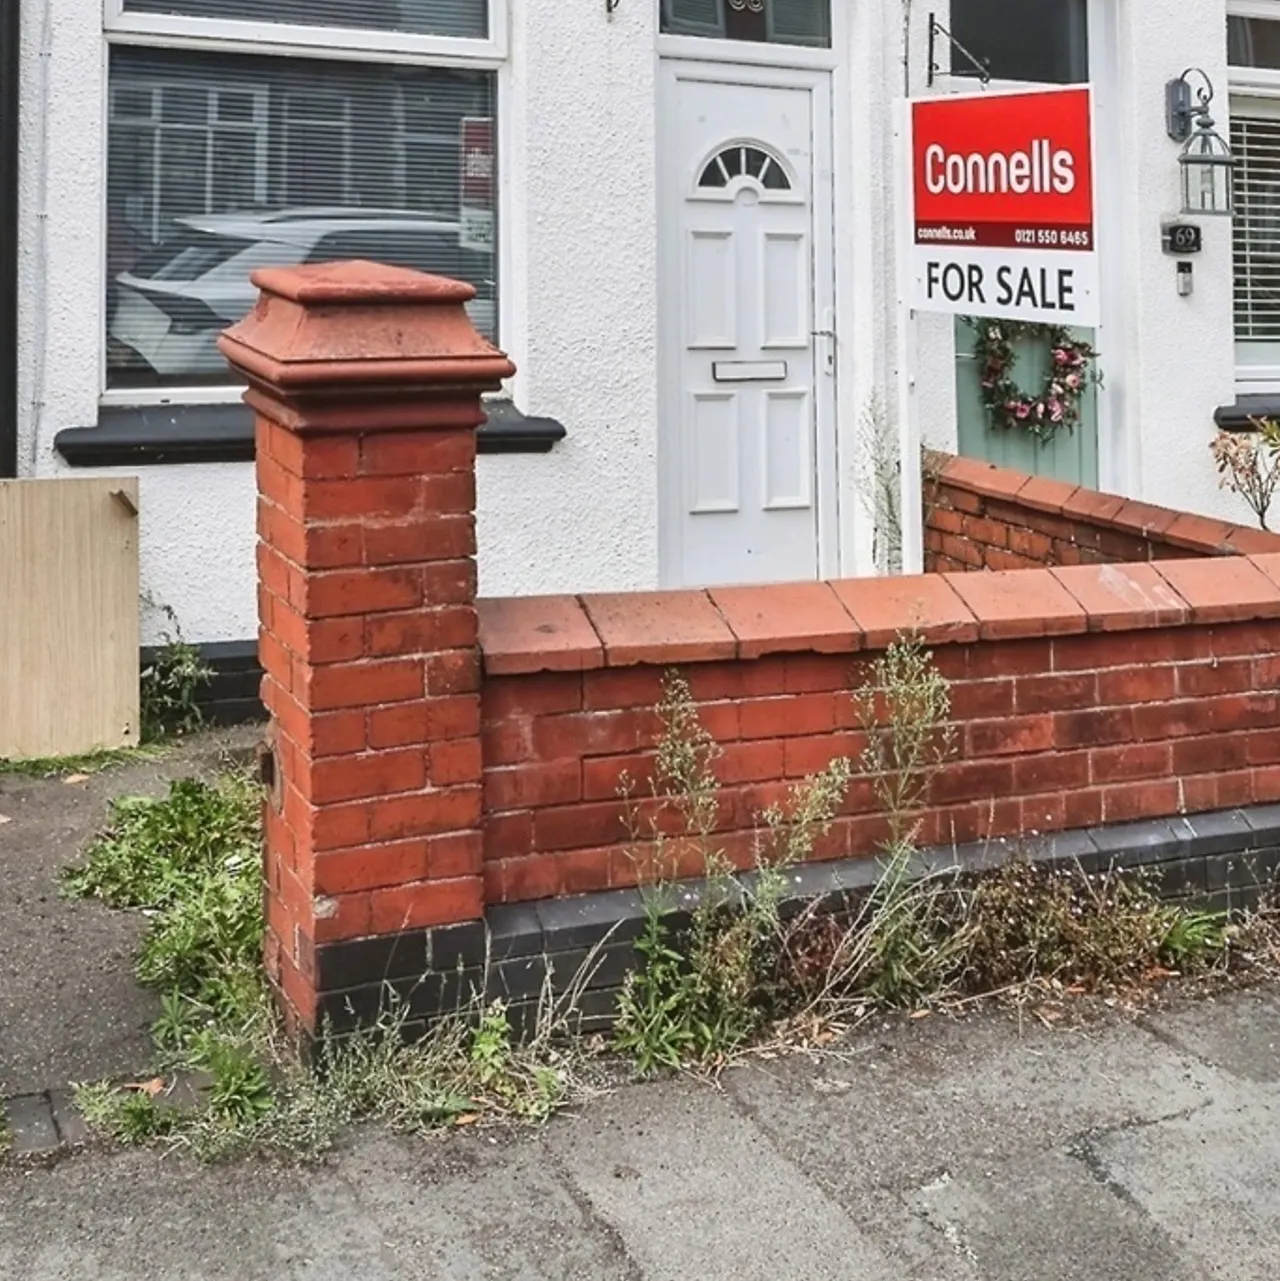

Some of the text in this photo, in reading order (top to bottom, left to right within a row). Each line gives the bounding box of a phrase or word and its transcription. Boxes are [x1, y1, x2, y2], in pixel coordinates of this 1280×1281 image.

[925, 138, 1075, 195] Connells
[917, 225, 976, 240] connells.co.uk
[1014, 229, 1035, 244] 0121
[1037, 229, 1058, 245] 550
[1175, 227, 1195, 246] 69
[926, 261, 1075, 311] FOR SALE
